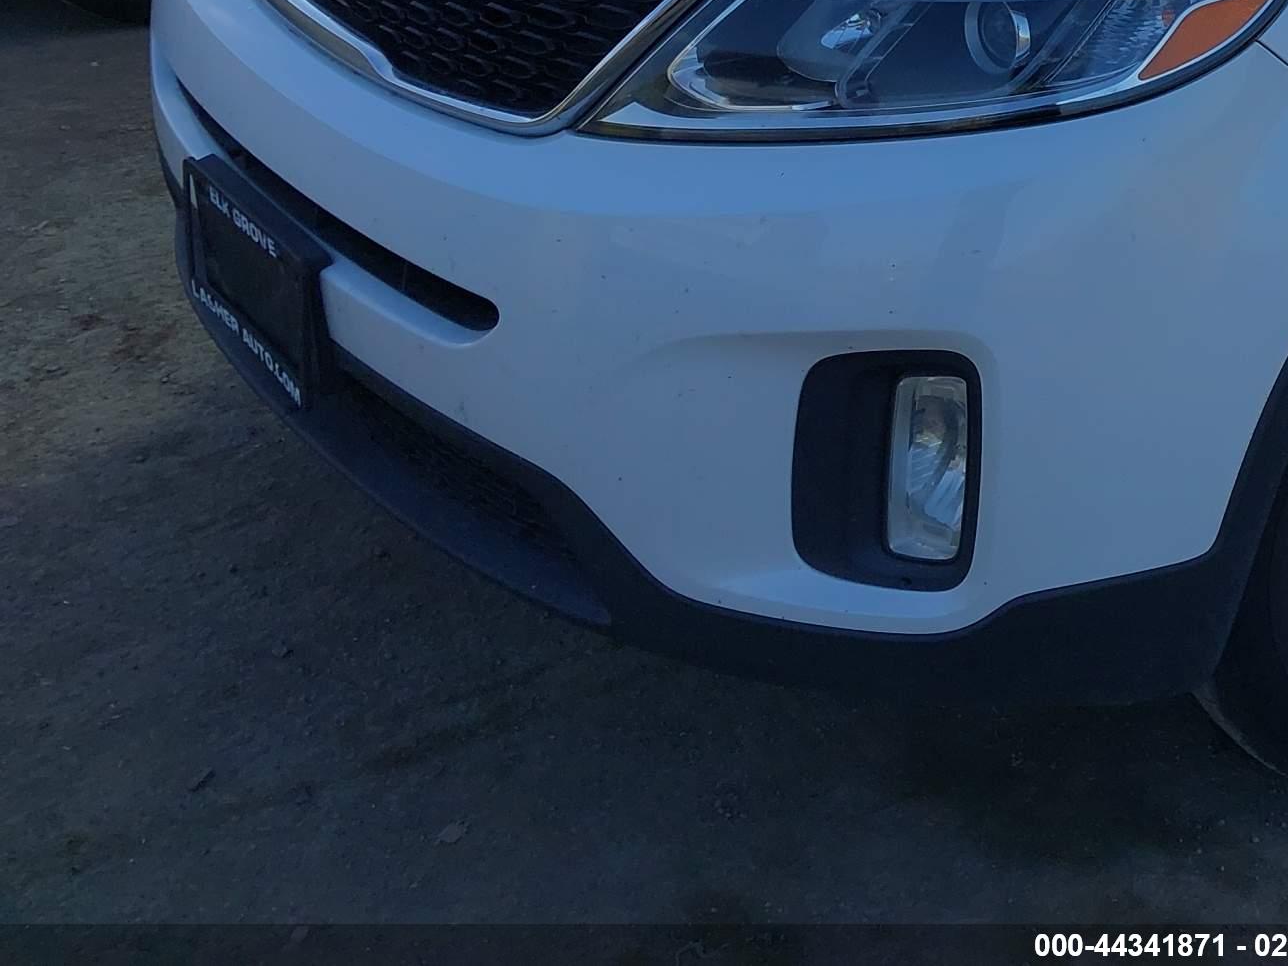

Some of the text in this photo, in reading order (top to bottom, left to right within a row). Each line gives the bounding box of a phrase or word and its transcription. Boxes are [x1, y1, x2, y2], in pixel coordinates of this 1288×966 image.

[209, 186, 279, 259] ELK GROVE
[191, 278, 240, 338] LASHER
